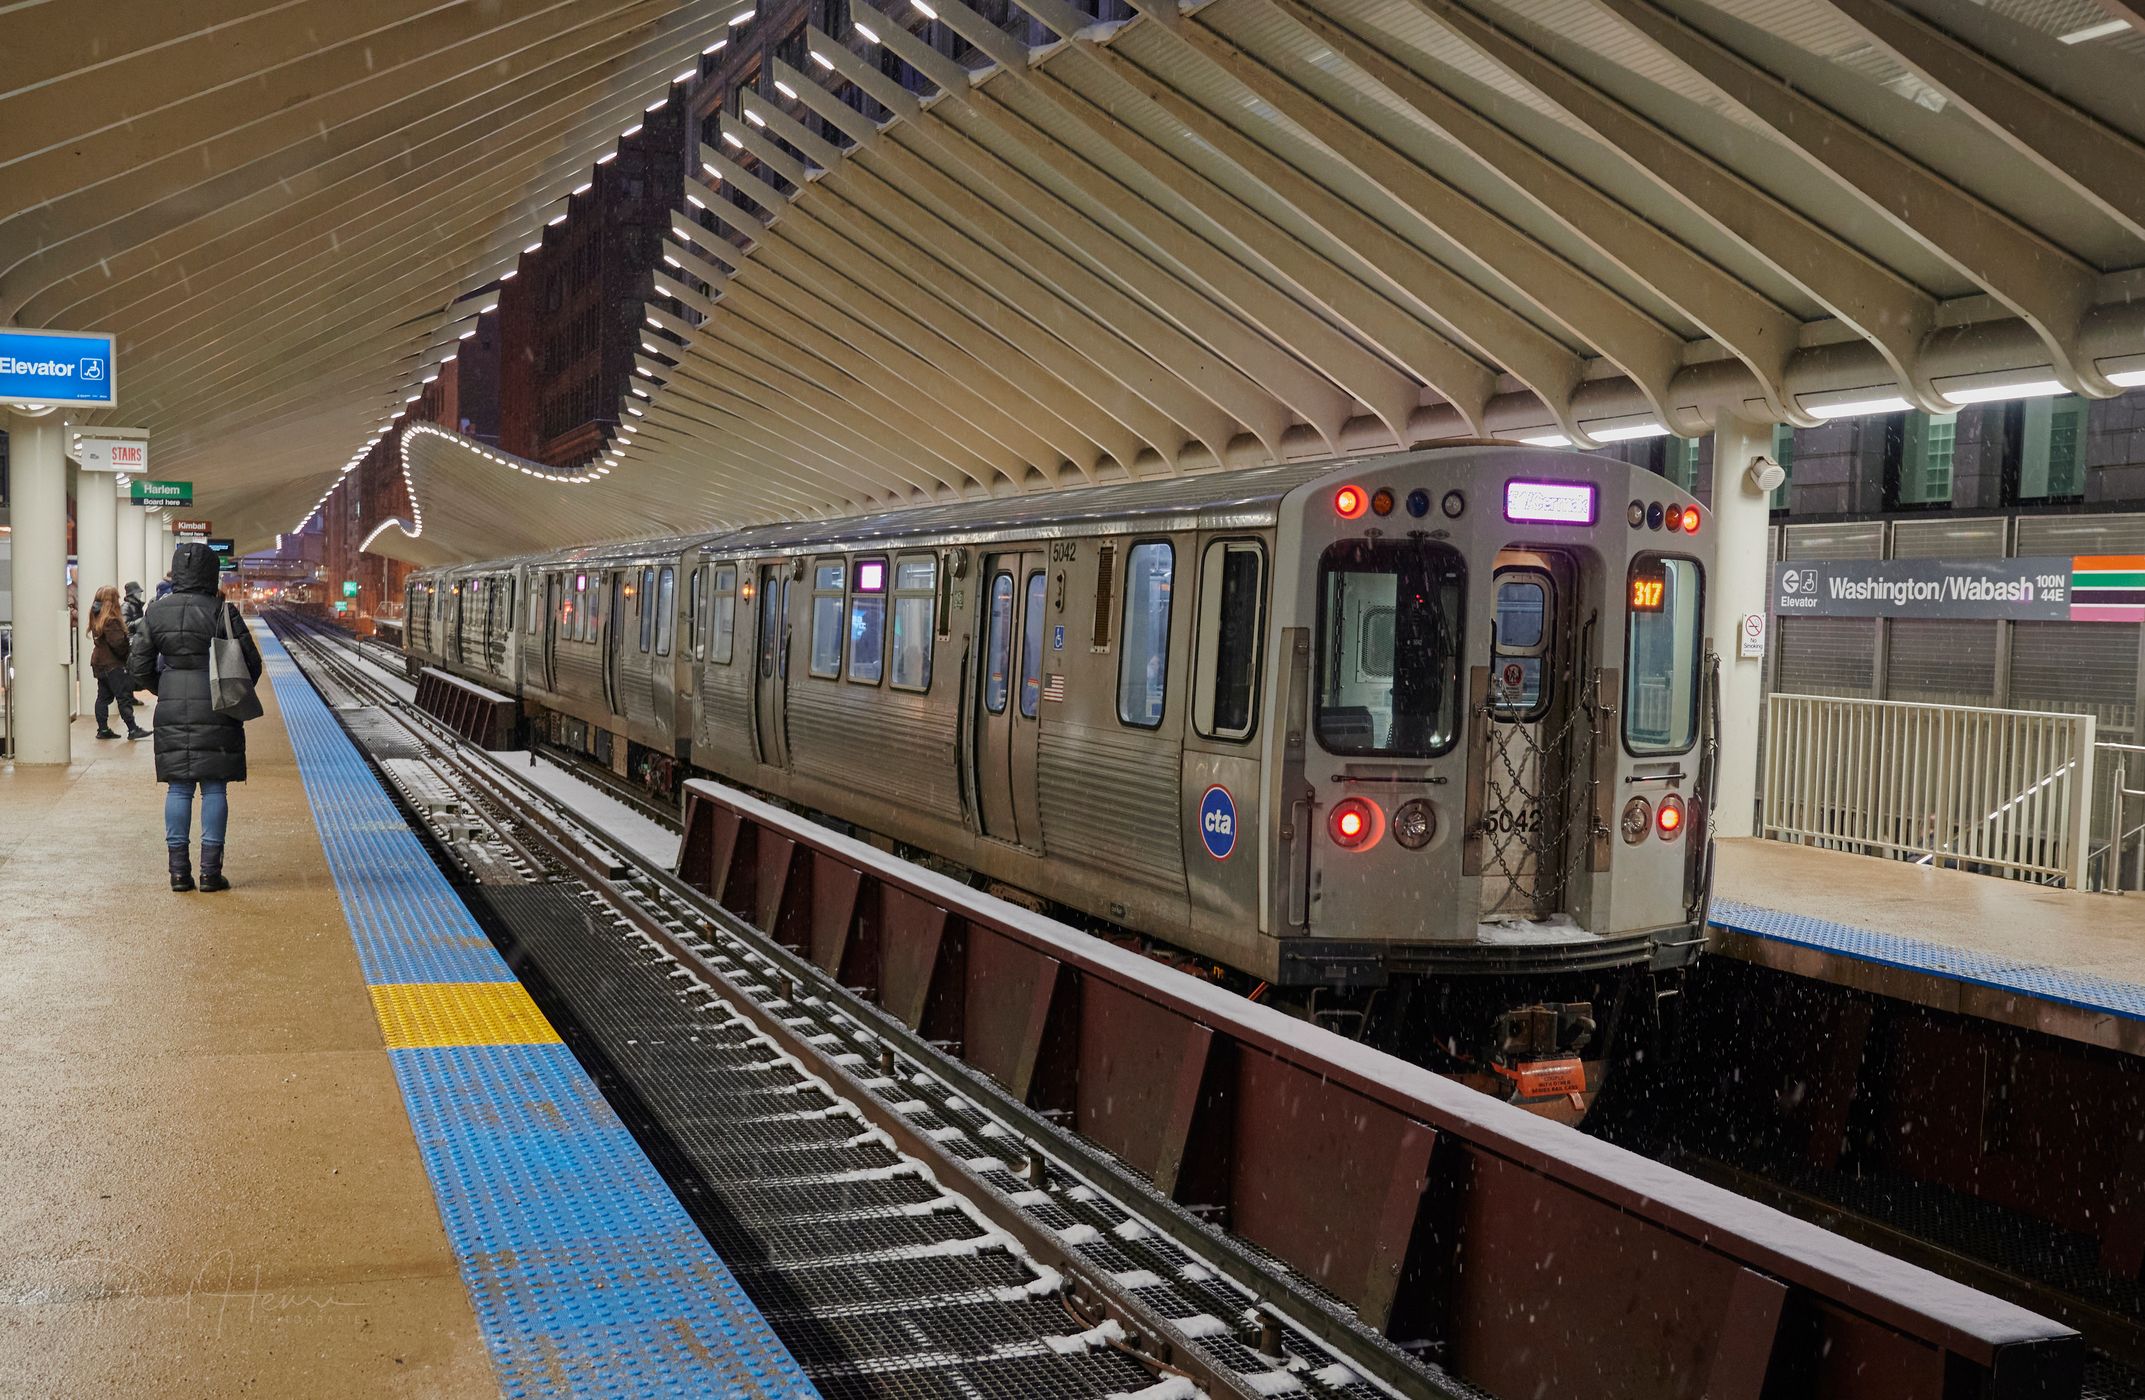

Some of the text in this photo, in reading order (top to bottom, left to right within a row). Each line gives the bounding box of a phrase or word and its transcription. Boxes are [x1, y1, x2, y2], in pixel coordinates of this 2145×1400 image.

[0, 357, 75, 377] Elevator
[112, 447, 142, 462] STAIRS
[144, 484, 180, 494] Harlem
[178, 521, 206, 530] Kimball
[1053, 542, 1076, 562] 5042
[2035, 575, 2065, 587] 100N
[1634, 582, 1662, 606] 317
[1829, 576, 2034, 606] Washington/Wabash
[2040, 589, 2065, 602] 44E
[1781, 596, 1818, 607] Elevator
[1205, 808, 1231, 835] cta
[1485, 809, 1542, 833] 5042
